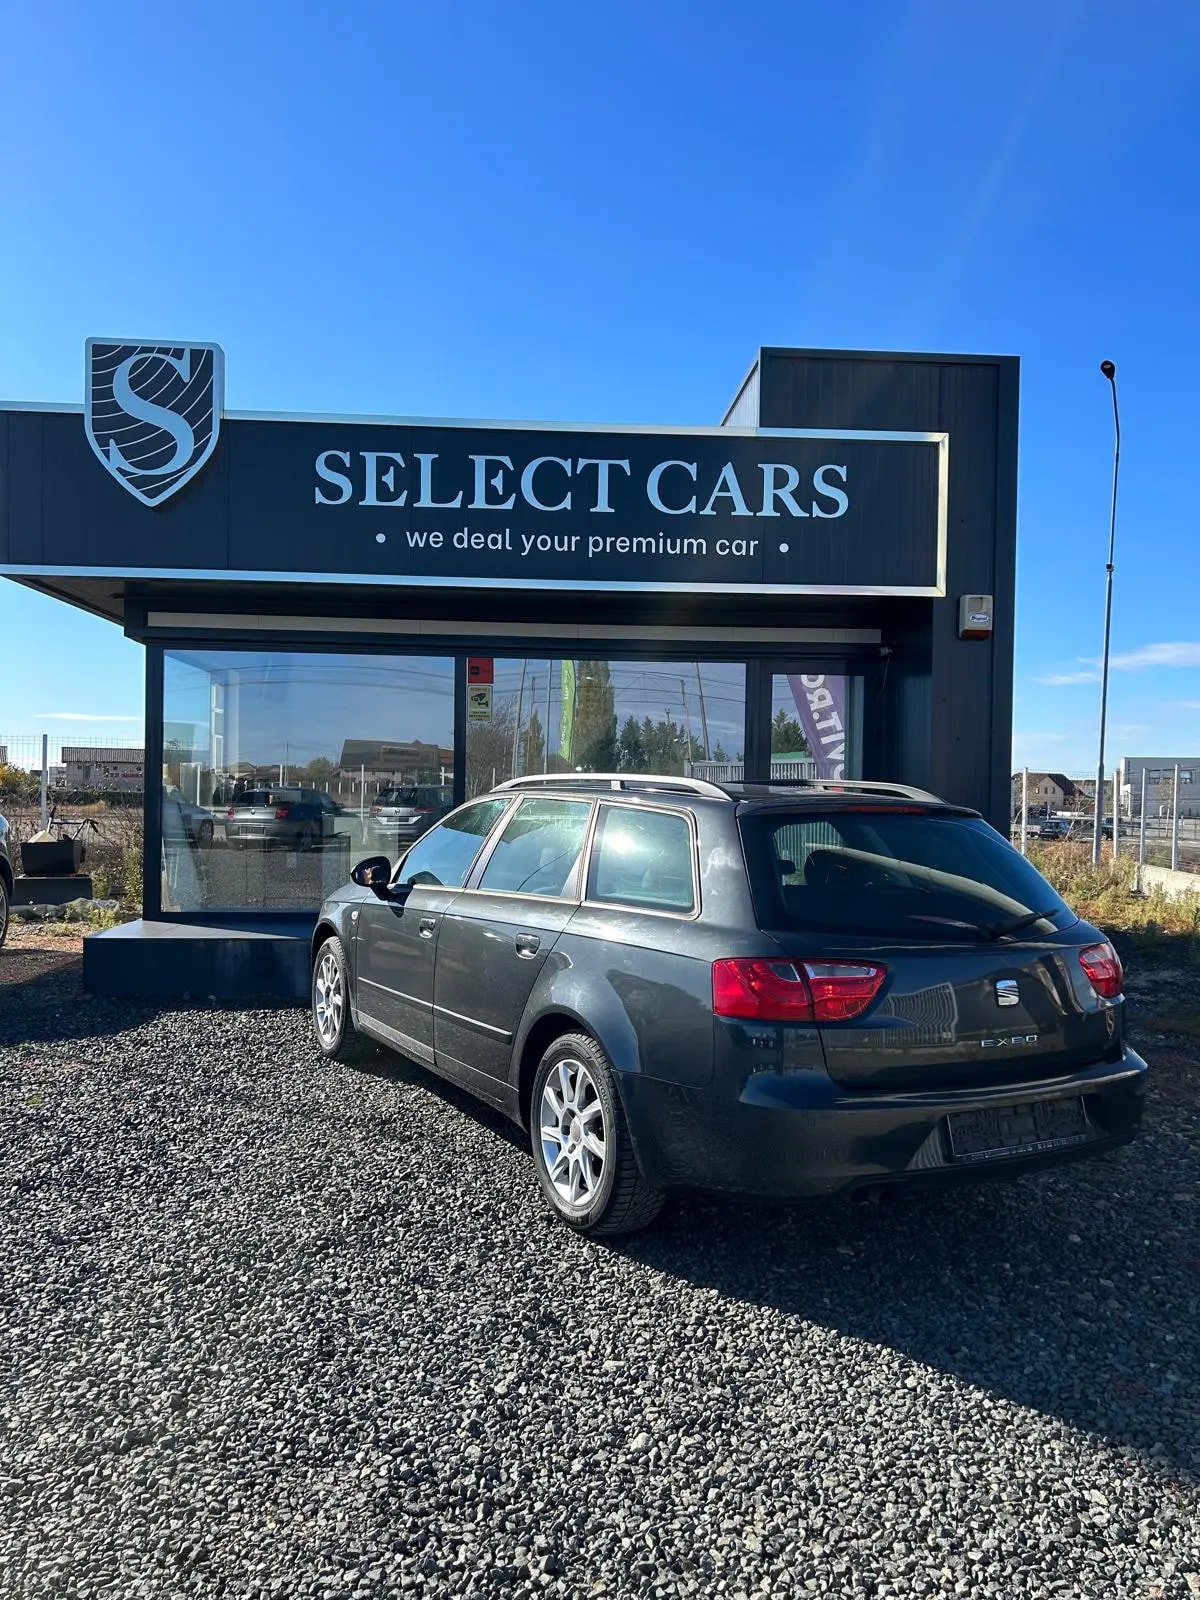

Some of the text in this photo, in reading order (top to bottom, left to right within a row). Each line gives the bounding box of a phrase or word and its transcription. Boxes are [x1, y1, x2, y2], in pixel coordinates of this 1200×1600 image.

[112, 348, 195, 476] S
[314, 450, 849, 519] SELECT CARS
[405, 526, 759, 558] we deal your premium car
[981, 1034, 1038, 1048] EXEO
